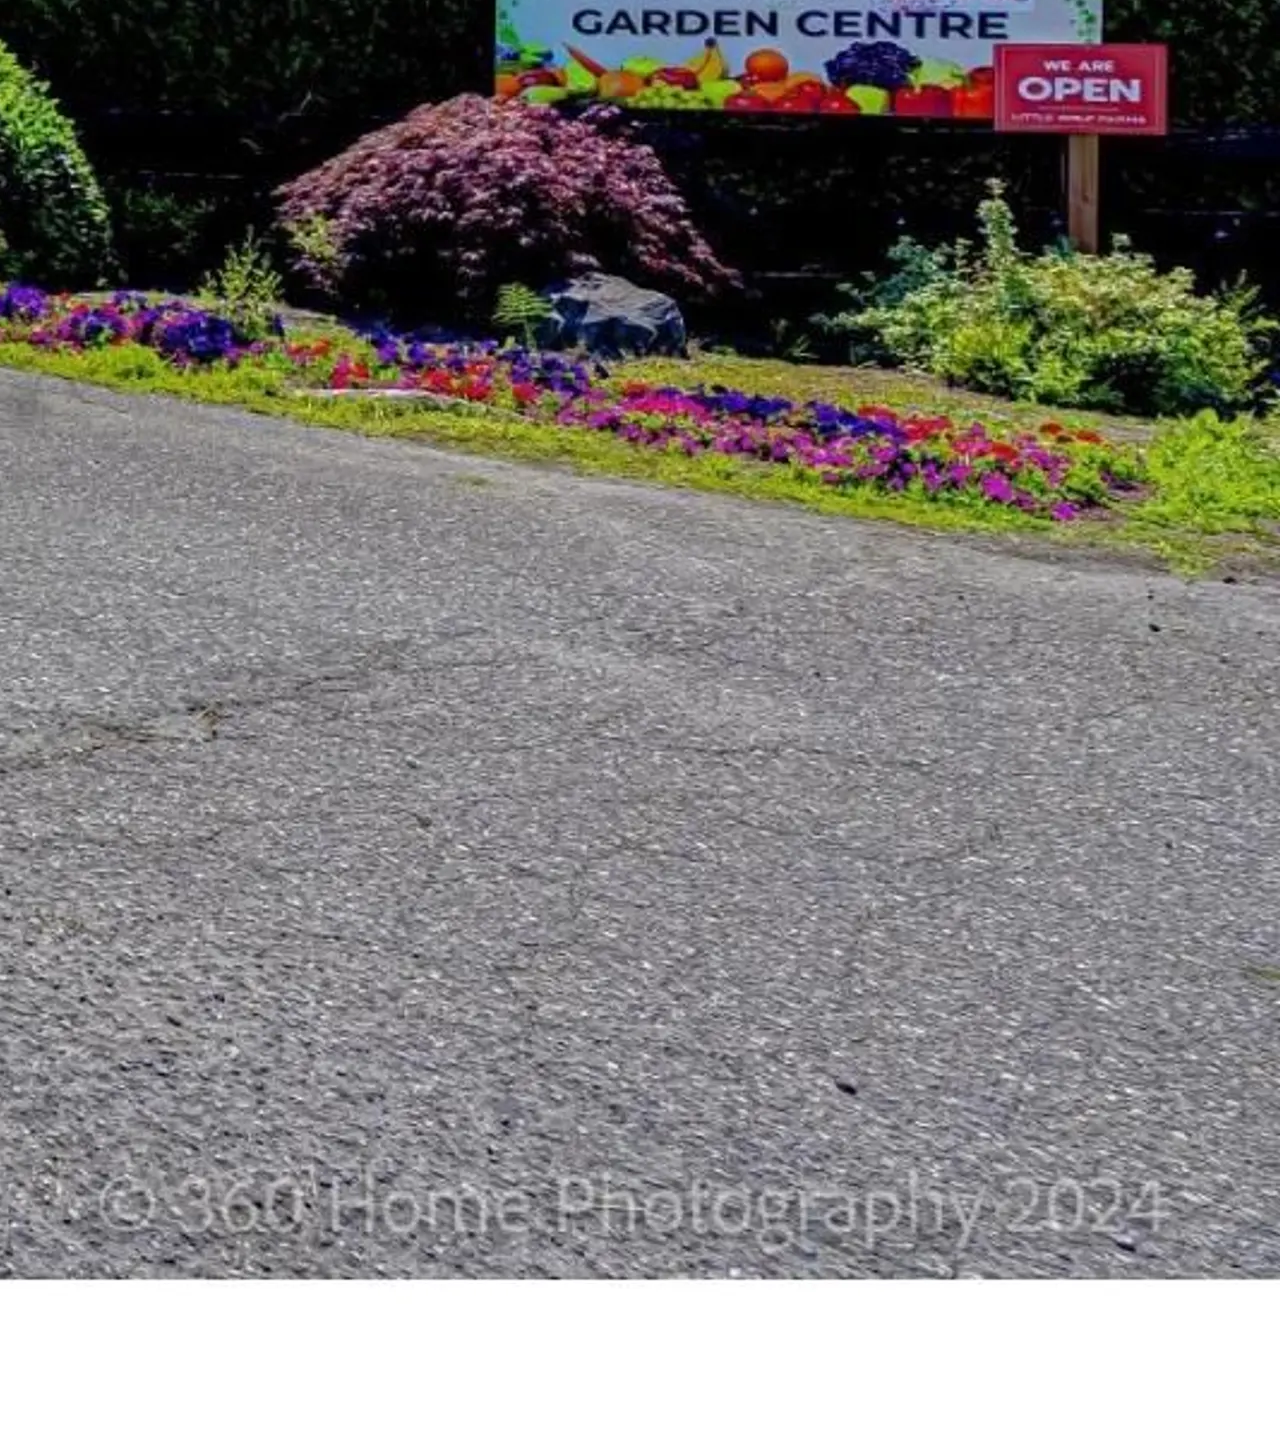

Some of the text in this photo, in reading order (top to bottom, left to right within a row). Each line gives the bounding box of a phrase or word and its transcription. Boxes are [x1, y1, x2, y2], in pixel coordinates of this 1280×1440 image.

[571, 8, 1009, 40] GARDEN CENTRE
[1043, 60, 1115, 73] WE ARE
[1017, 76, 1142, 103] OPEN
